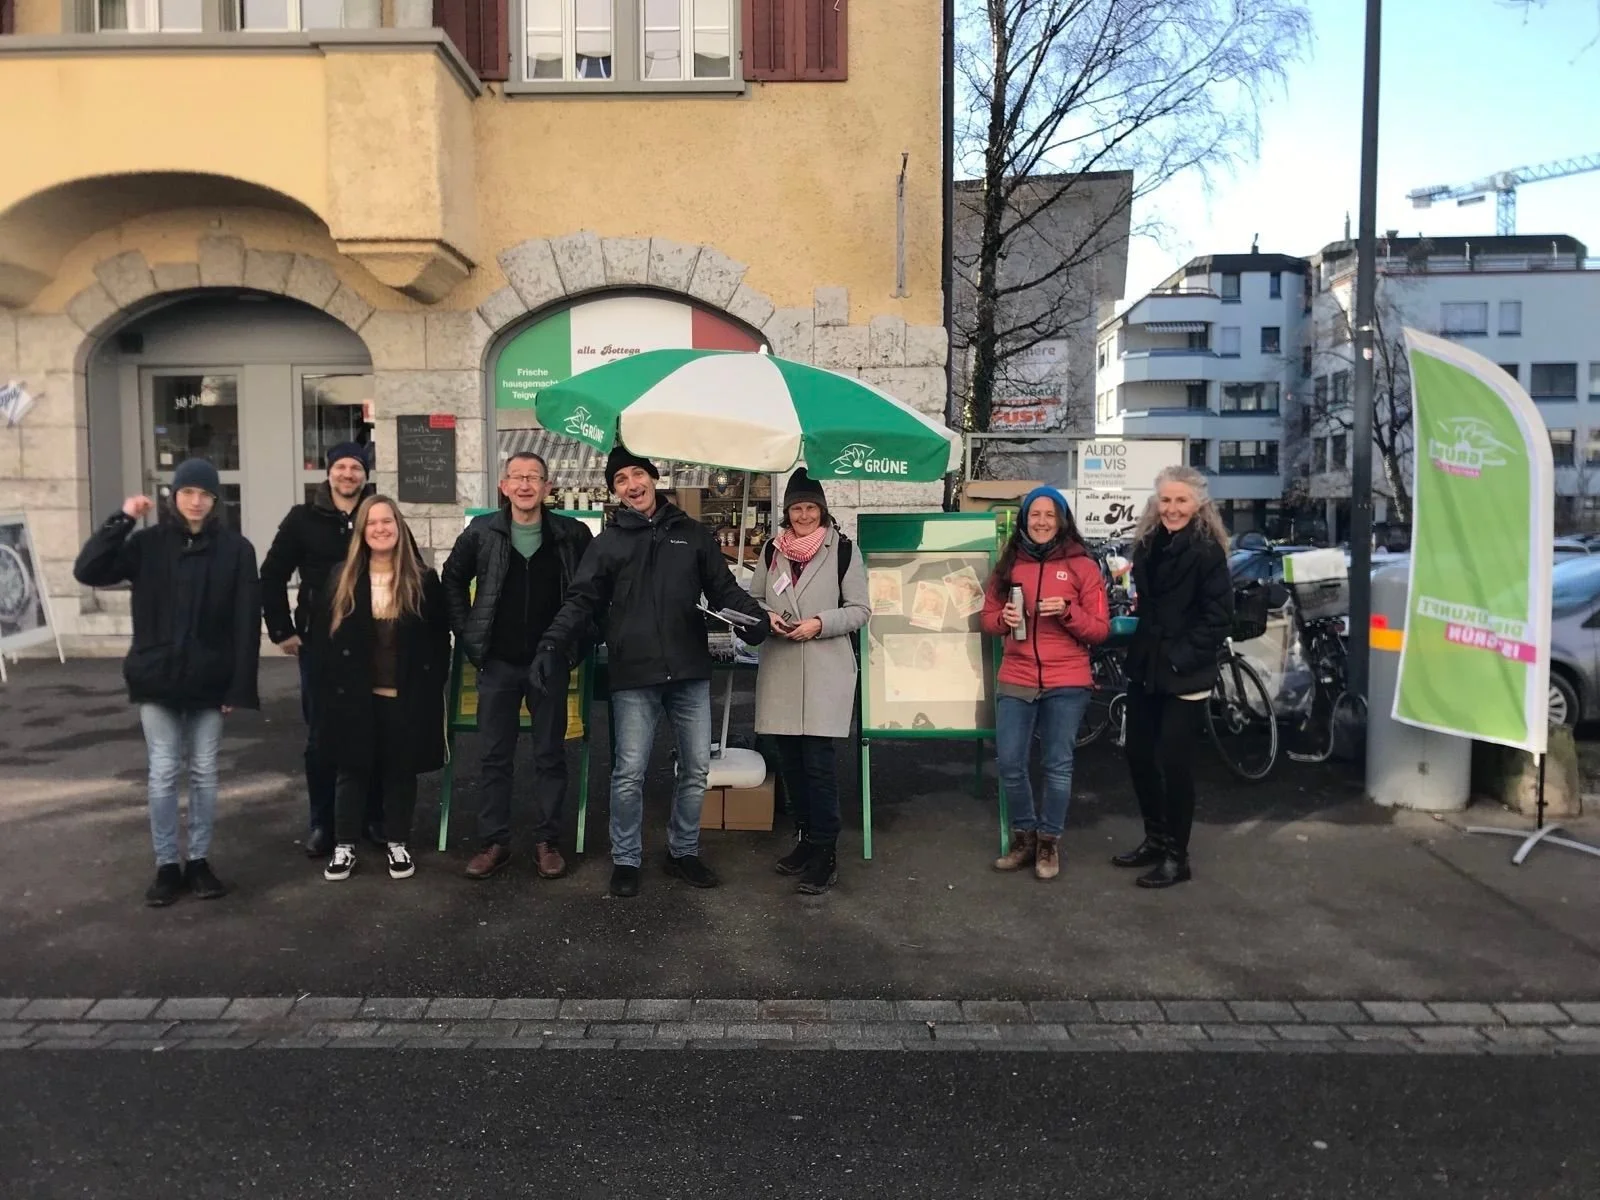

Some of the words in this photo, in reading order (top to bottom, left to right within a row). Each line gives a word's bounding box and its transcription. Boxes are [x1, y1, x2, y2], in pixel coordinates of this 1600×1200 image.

[577, 346, 596, 355] alla
[600, 344, 641, 356] Bottega
[517, 368, 549, 377] Frische
[512, 391, 537, 401] Teigw
[582, 424, 605, 443] GRÜNE
[1084, 444, 1127, 457] AUDIO
[864, 457, 908, 475] GRÜNE
[1103, 458, 1127, 471] VIS
[1102, 492, 1132, 501] Bottega
[1085, 511, 1101, 522] da
